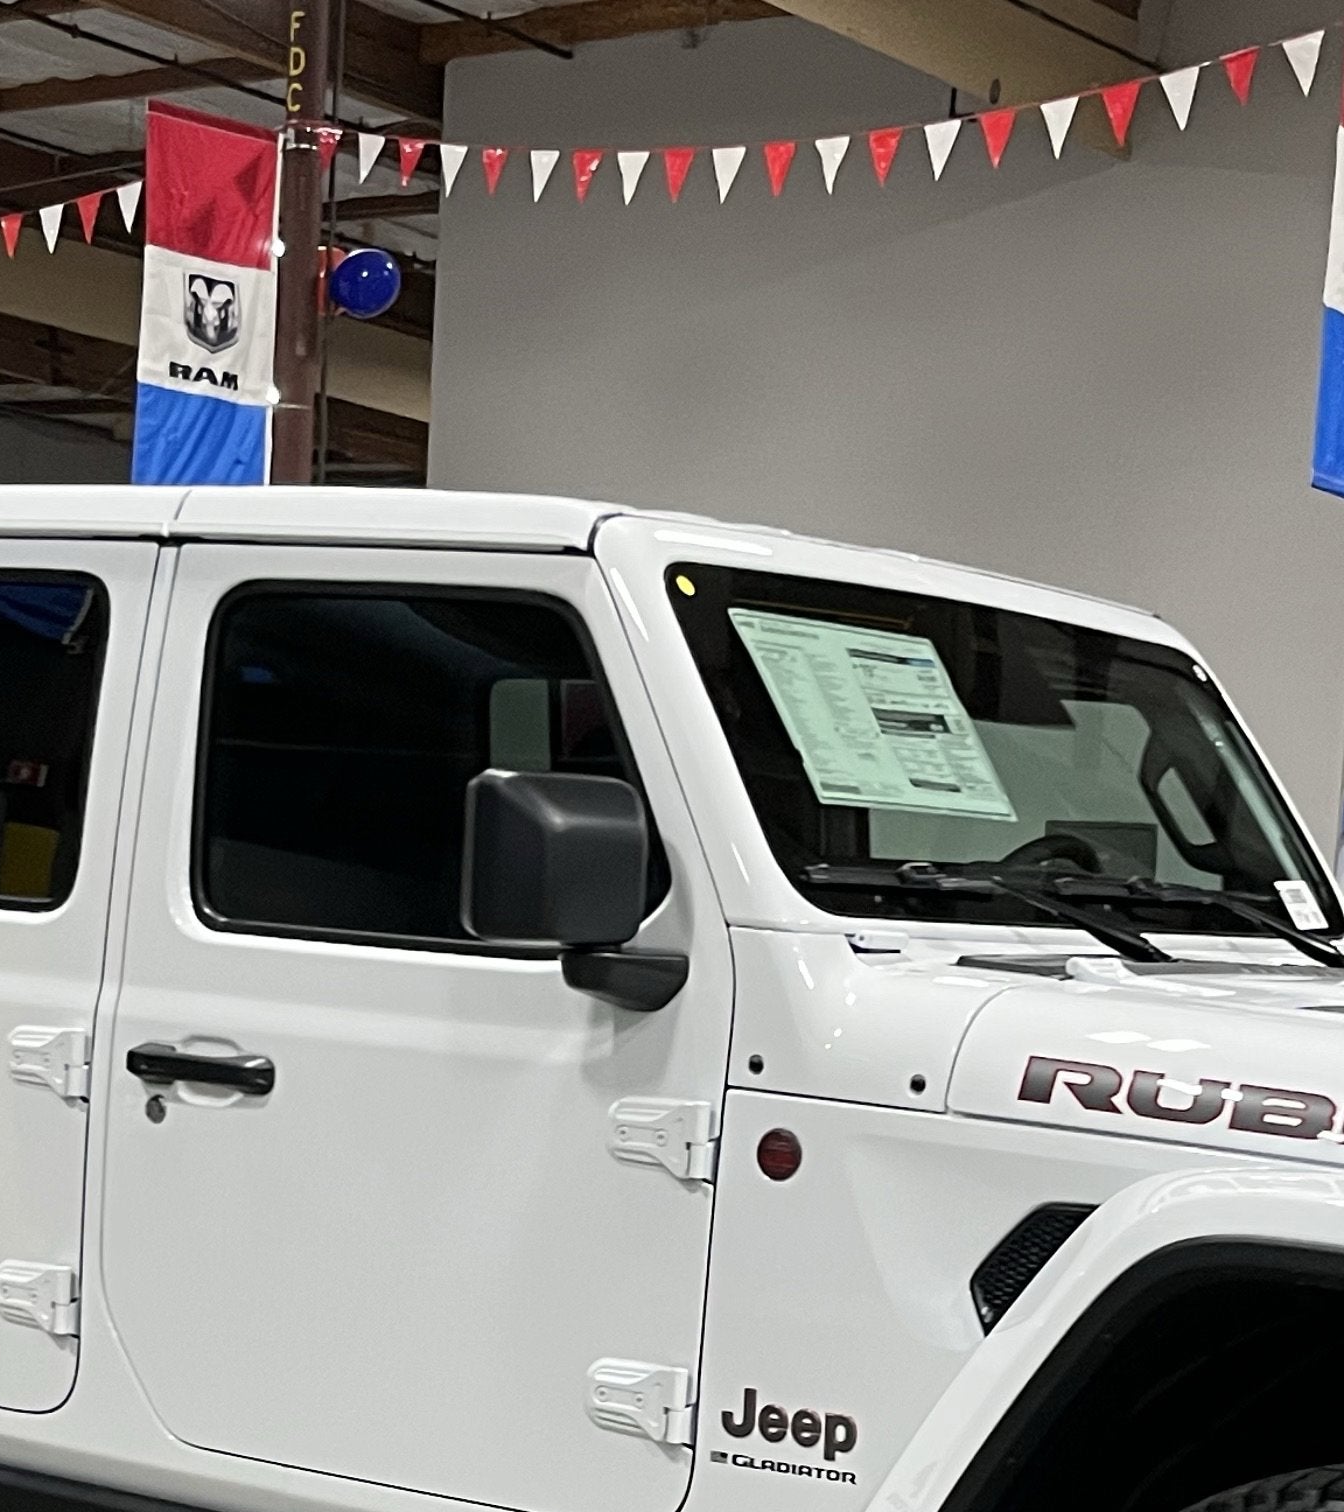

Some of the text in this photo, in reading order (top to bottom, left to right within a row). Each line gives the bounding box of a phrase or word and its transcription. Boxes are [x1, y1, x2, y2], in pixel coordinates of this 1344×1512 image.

[169, 361, 238, 391] RAM
[720, 1387, 858, 1462] Jeep
[731, 1453, 858, 1486] GLADIATOR
